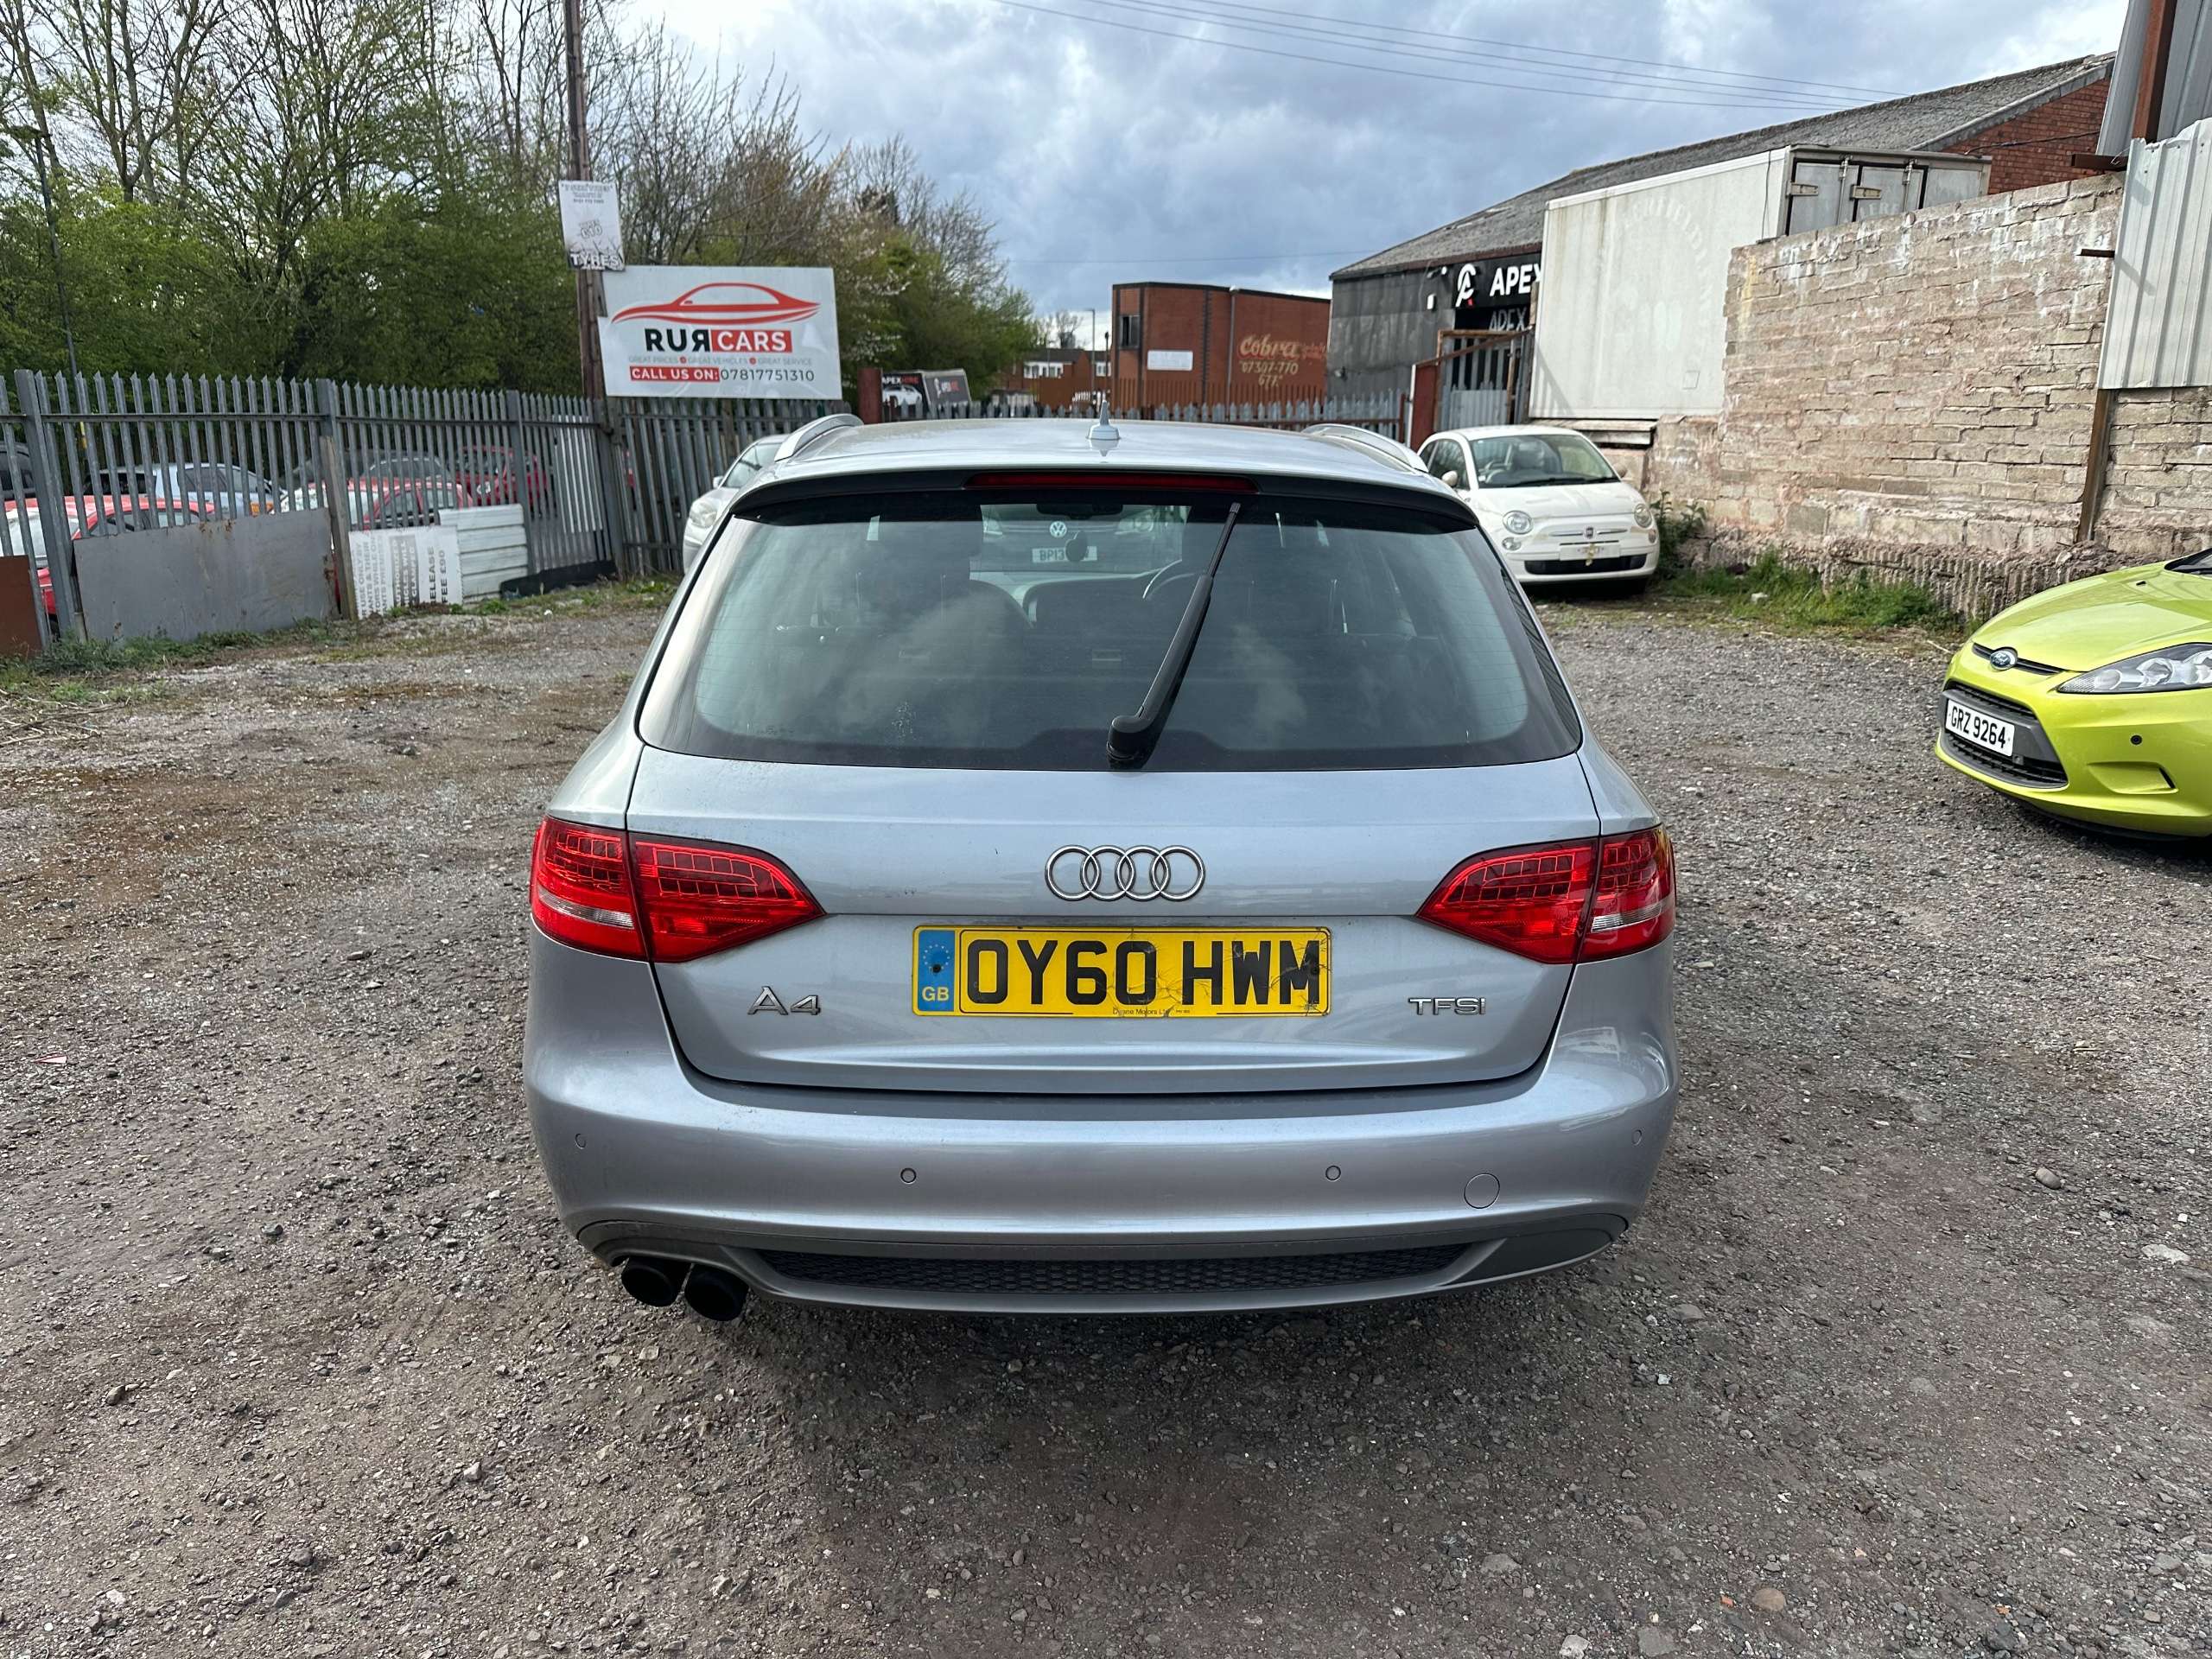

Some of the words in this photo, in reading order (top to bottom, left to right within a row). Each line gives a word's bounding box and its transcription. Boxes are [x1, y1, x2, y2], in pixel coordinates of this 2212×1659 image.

[569, 252, 621, 267] TYRES
[1239, 334, 1300, 359] Cobra
[632, 367, 667, 379] CALL
[671, 369, 690, 379] US
[721, 369, 815, 382] 07817751310
[440, 579, 448, 604] FEE
[1951, 705, 1972, 735] GRZ
[1973, 715, 2007, 749] 9264
[966, 938, 1158, 1006] OY60
[1182, 939, 1320, 1007] HWM
[747, 985, 822, 1016] A4
[922, 986, 950, 1001] GB
[1408, 996, 1486, 1016] TFSI
